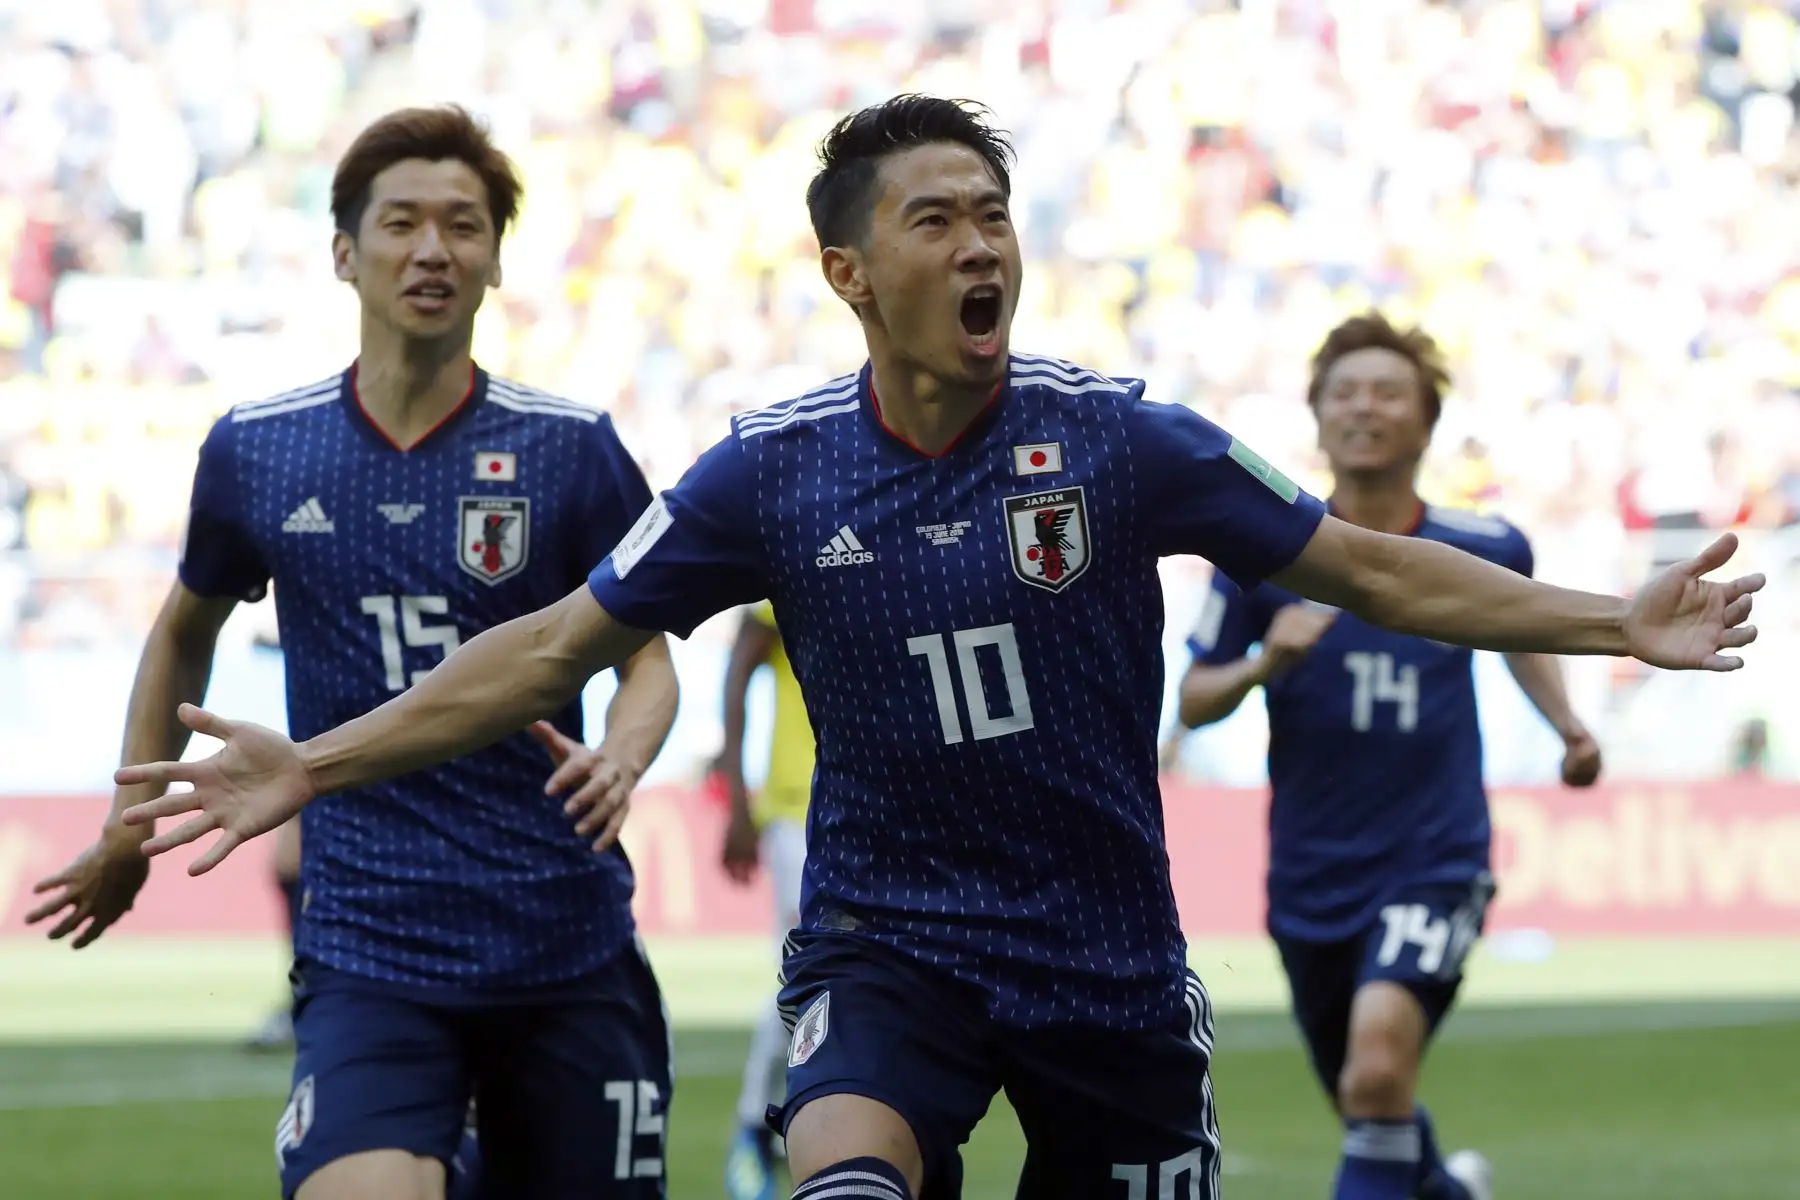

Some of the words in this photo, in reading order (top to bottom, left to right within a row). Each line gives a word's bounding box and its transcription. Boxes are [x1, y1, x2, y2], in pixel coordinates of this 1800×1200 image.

[1024, 494, 1064, 507] JAPAN
[815, 549, 875, 568] adidas
[361, 595, 460, 690] 15
[906, 622, 1035, 745] 10
[1343, 651, 1420, 733] 14
[1375, 903, 1450, 975] 14
[604, 1080, 665, 1179] 15
